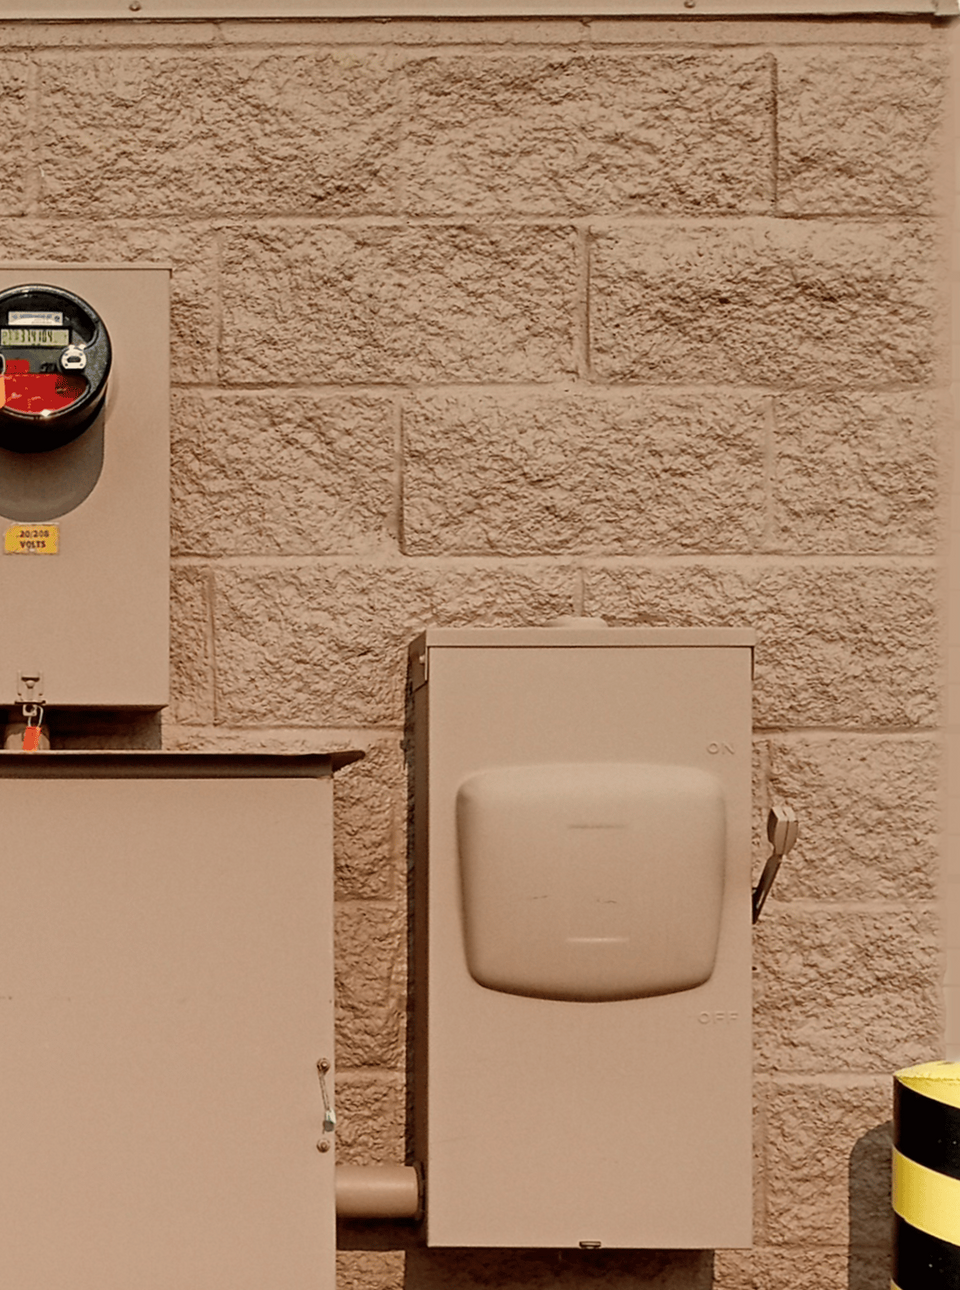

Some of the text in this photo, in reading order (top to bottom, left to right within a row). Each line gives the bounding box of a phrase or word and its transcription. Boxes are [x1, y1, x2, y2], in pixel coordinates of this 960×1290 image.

[17, 530, 50, 538] 20/208
[19, 540, 47, 549] VOLTS
[706, 740, 736, 755] ON
[696, 1010, 739, 1025] OFF
